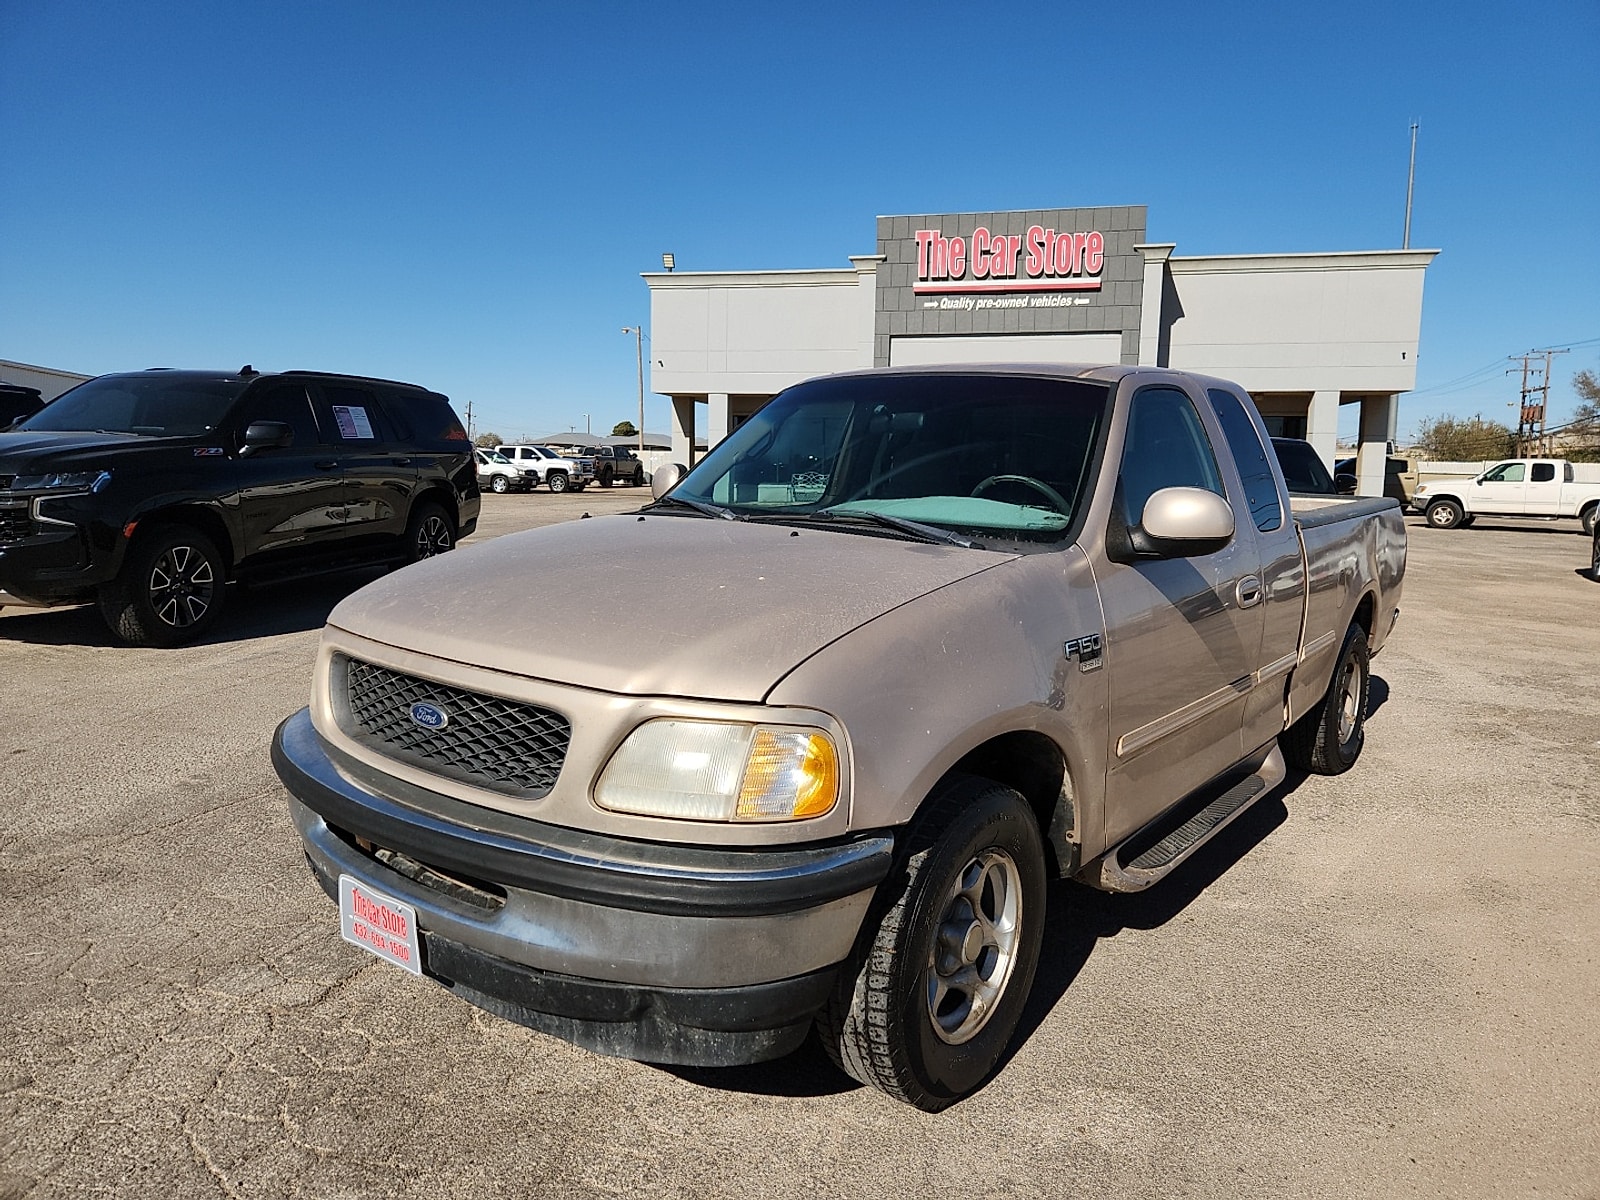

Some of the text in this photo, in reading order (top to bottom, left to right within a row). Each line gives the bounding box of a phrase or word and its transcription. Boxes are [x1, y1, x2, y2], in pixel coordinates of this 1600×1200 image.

[915, 225, 1104, 279] The Car Store
[940, 294, 1073, 311] Quality pre-owned vehicles
[416, 706, 438, 724] Ford
[351, 887, 367, 917] The
[366, 898, 381, 926] Car
[380, 903, 408, 939] Store
